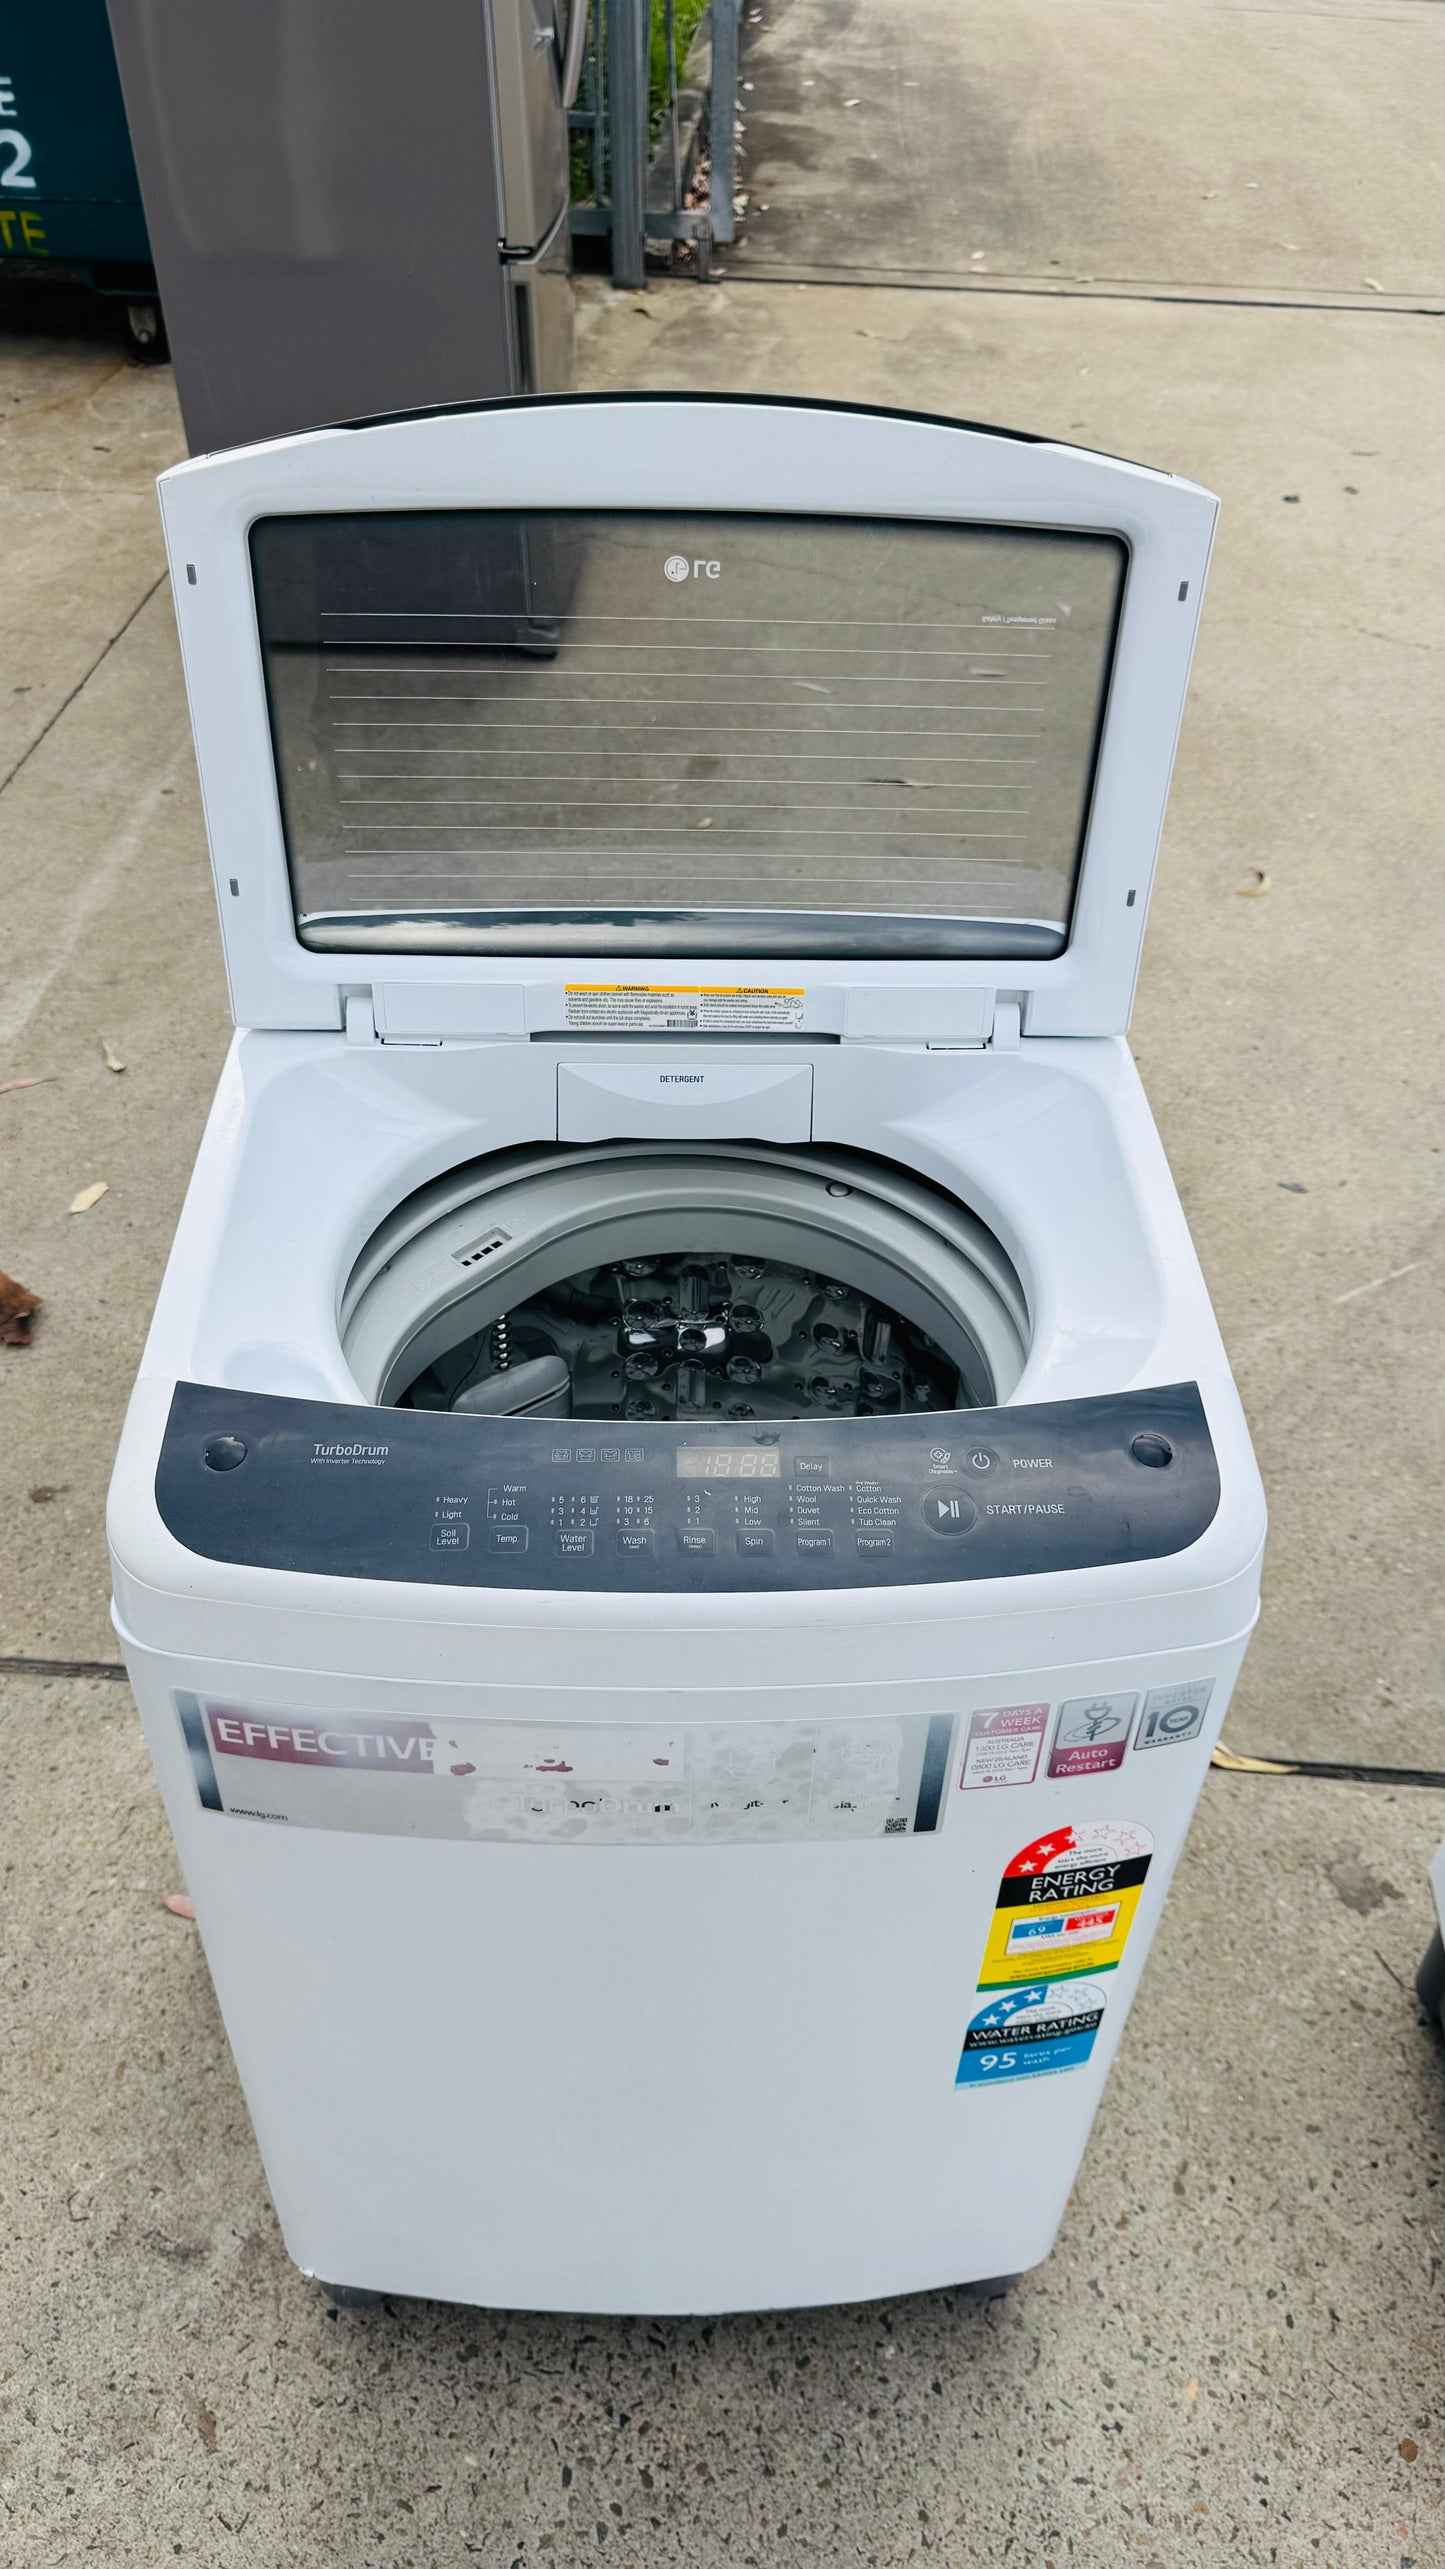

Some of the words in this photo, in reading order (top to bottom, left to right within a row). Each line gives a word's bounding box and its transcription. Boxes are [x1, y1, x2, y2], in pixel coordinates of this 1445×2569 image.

[659, 1075, 704, 1083] DETERGENT
[313, 1443, 389, 1456] TurboDrum
[800, 1462, 823, 1471] Delay
[1013, 1458, 1053, 1469] POWER
[796, 1484, 822, 1492] Cotton
[823, 1484, 845, 1492] Wash
[443, 1496, 468, 1505] Heavy
[559, 1496, 565, 1504] 5
[624, 1495, 634, 1503] 18
[644, 1495, 654, 1503] 25
[694, 1495, 700, 1503] 3
[744, 1496, 762, 1504] High
[796, 1495, 817, 1503] Wool
[857, 1496, 878, 1504] Quick
[879, 1496, 902, 1504] Wash
[559, 1507, 564, 1515] 3
[580, 1507, 586, 1515] 4
[694, 1506, 700, 1514] 2
[744, 1506, 759, 1514] Mid
[858, 1507, 872, 1515] Eco
[874, 1507, 899, 1515] Cotton
[986, 1504, 1065, 1515] START/PAUSE
[441, 1511, 462, 1520] Light
[501, 1513, 519, 1521] Cold
[624, 1518, 630, 1526] 3
[644, 1518, 650, 1526] 6
[744, 1518, 762, 1526] Low
[798, 1518, 820, 1526] Silent
[859, 1518, 873, 1526] Tub
[874, 1518, 896, 1526] Clean
[440, 1529, 457, 1537] Soil
[436, 1537, 459, 1546] Level
[560, 1534, 587, 1543] Water
[622, 1536, 647, 1545] Wash
[683, 1536, 706, 1544] Rinse
[745, 1537, 764, 1546] Spin
[798, 1538, 827, 1547] Program
[857, 1538, 887, 1548] Program
[562, 1544, 585, 1552] Level
[1003, 1709, 1031, 1718] DAYS
[978, 1711, 999, 1729] 7
[1001, 1716, 1042, 1727] WEEK
[1145, 1705, 1200, 1738] 10
[975, 1727, 1018, 1737] CUSTOMER
[1020, 1725, 1041, 1733] CARE
[987, 1736, 1024, 1744] AUSTRALIA
[975, 1744, 995, 1752] 1300
[994, 1754, 1028, 1762] ZEALAND
[1068, 1749, 1108, 1761] Auto
[971, 1763, 992, 1771] 0800
[1007, 1759, 1031, 1767] CARE
[1055, 1758, 1117, 1774] Restart
[230, 1807, 288, 1821] www.lg.com
[1031, 1864, 1121, 1890] ENERGY
[1029, 1878, 1115, 1903] RATING
[972, 2026, 1031, 2041] WATER
[1036, 2011, 1099, 2033] RATING
[980, 2052, 1018, 2072] 95
